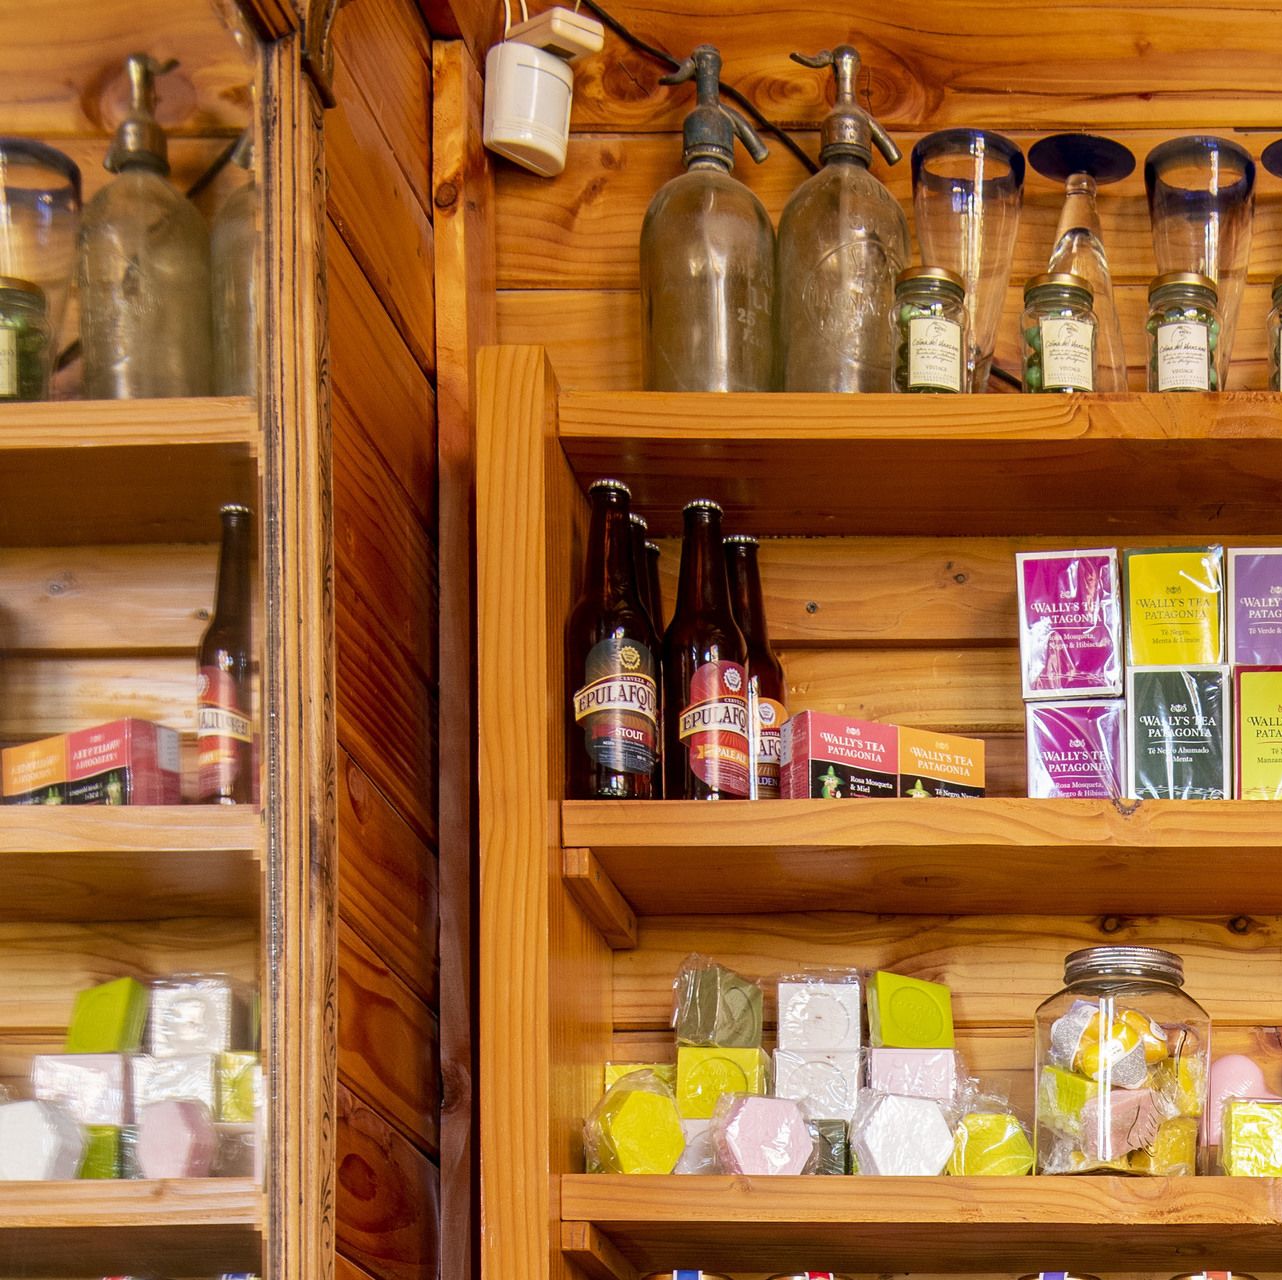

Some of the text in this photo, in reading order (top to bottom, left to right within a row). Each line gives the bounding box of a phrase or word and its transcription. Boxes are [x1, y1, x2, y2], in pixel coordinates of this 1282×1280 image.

[1136, 598, 1211, 609] WALLY'S TEA
[1145, 610, 1206, 619] PATAGONIA
[1192, 716, 1216, 726] TEA
[615, 727, 644, 741] STOUT
[820, 732, 885, 753] WALLY'S TEA
[828, 746, 882, 763] PATAGONIA
[910, 747, 973, 767] WALLY'S TEA
[1040, 750, 1088, 761] WALLY'S
[917, 760, 970, 777] PATAGONIA
[850, 776, 865, 784] Rosa
[856, 784, 870, 793] Miel
